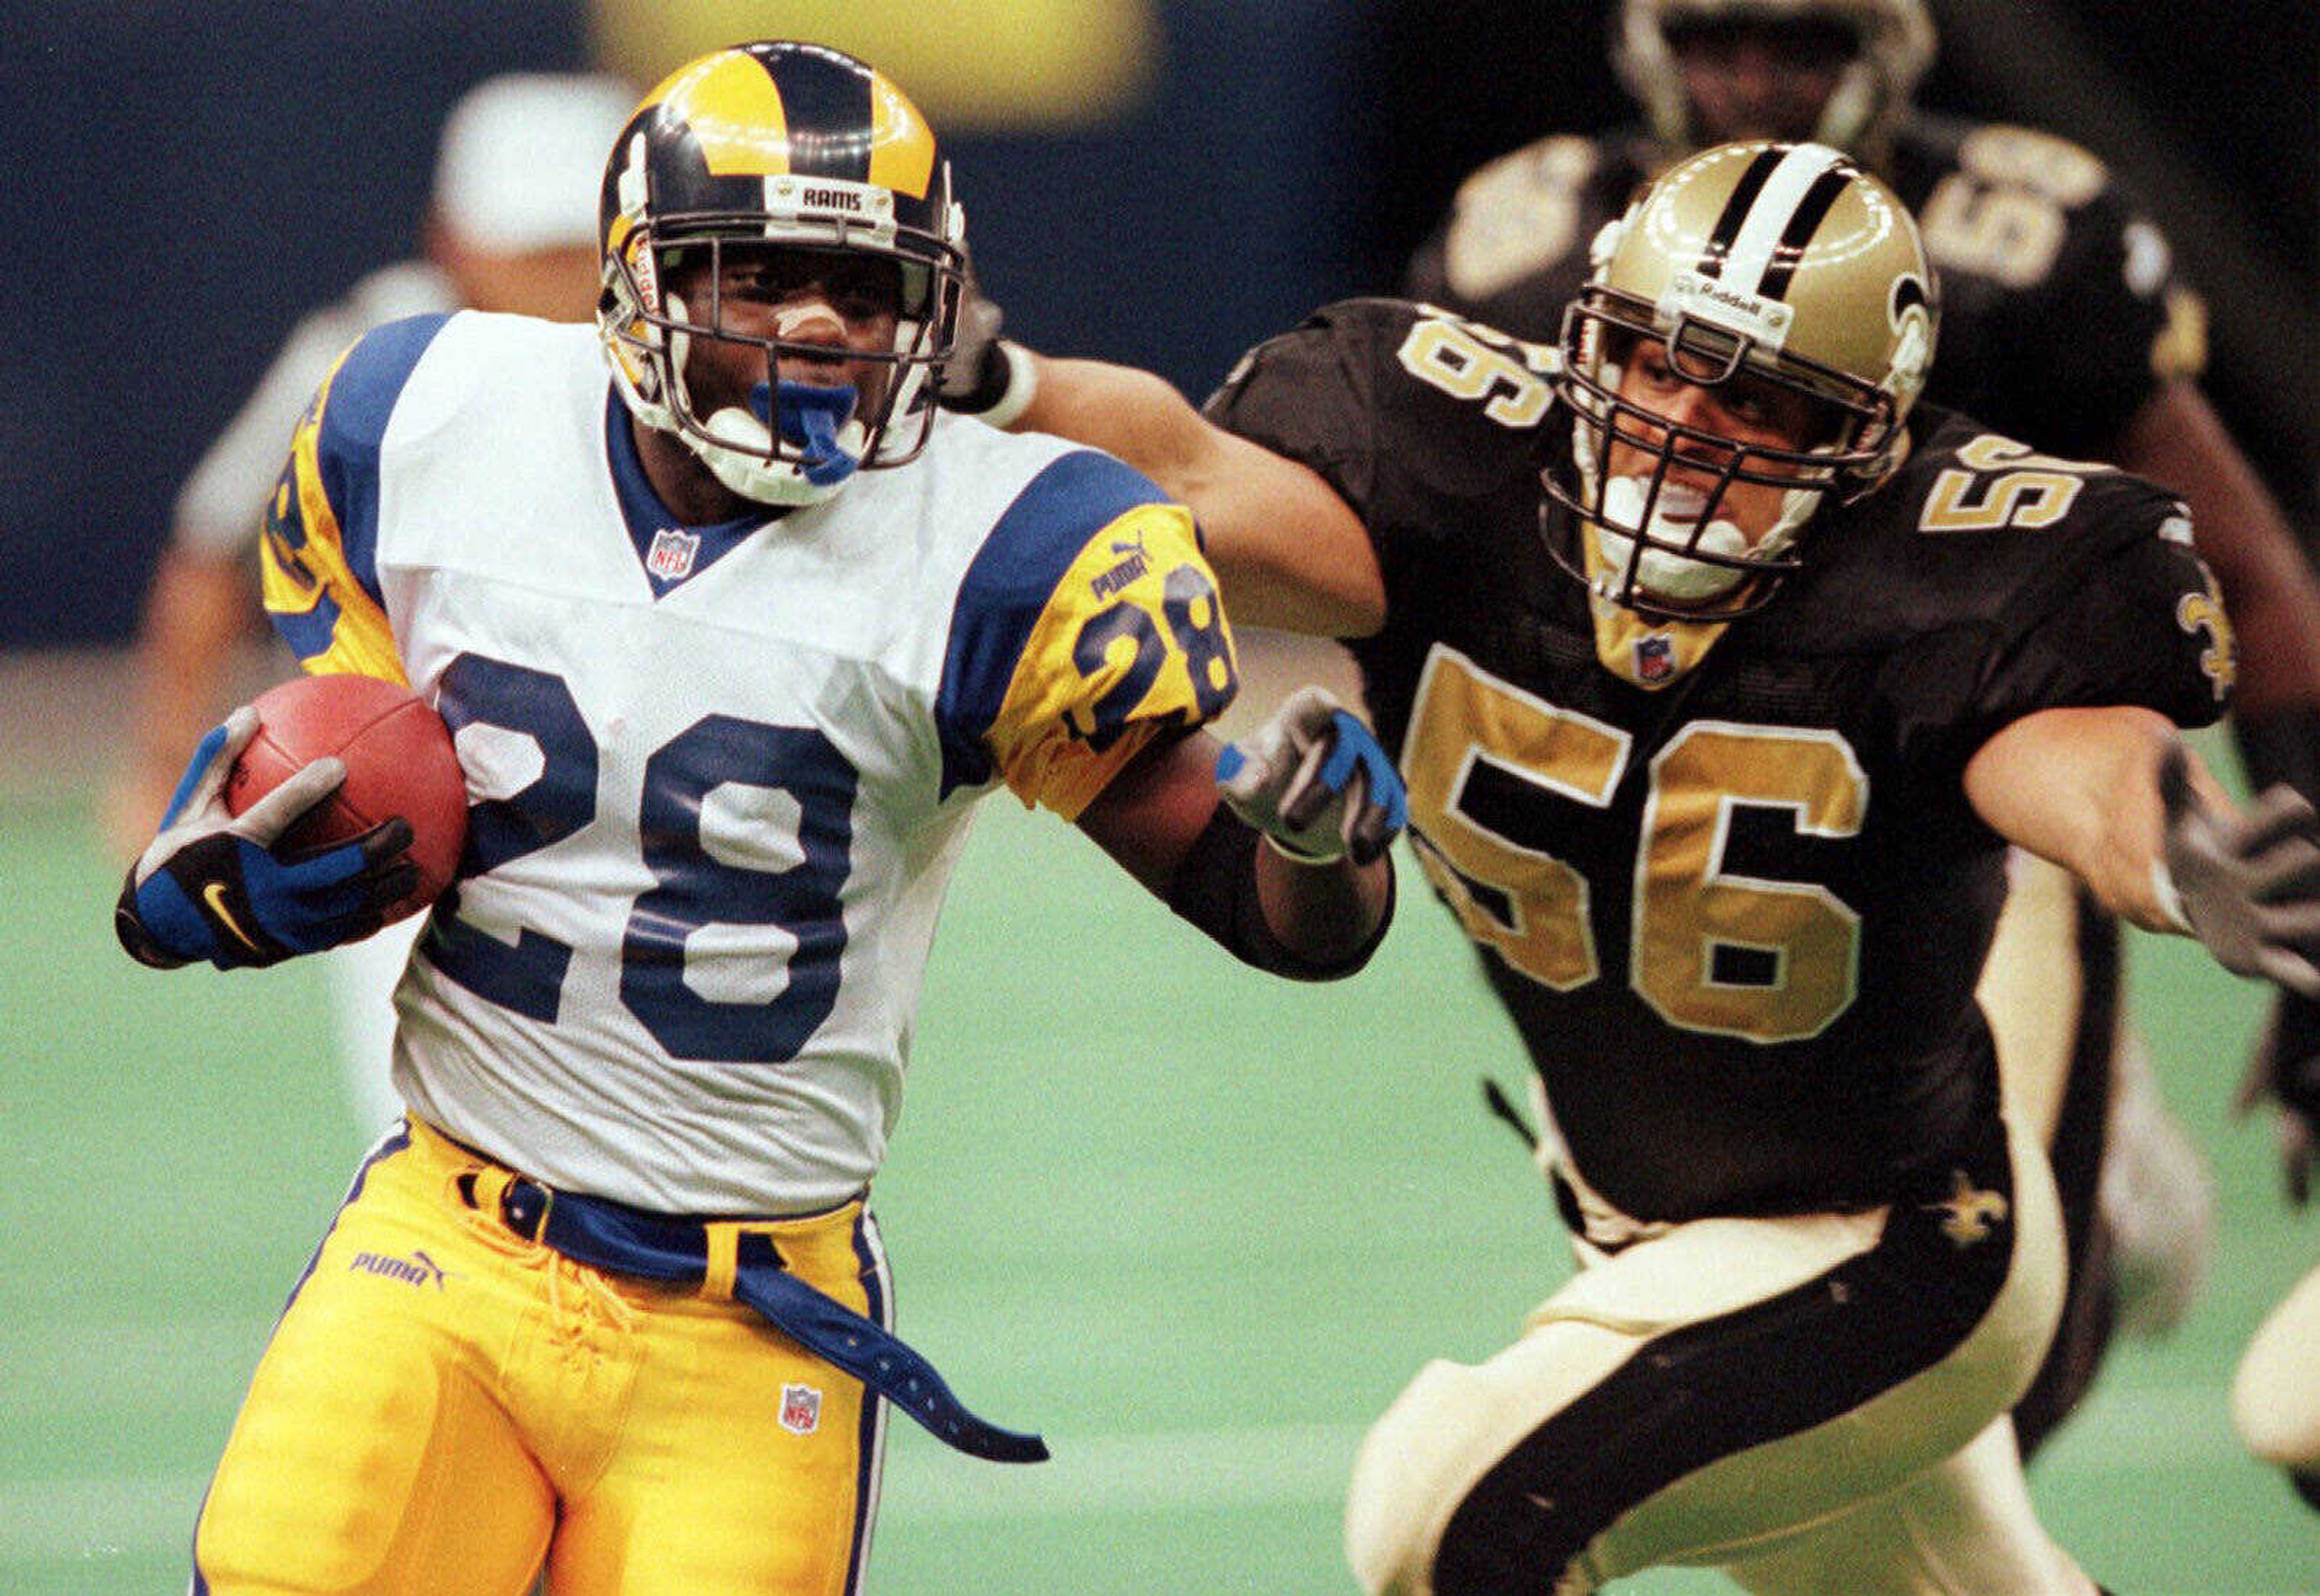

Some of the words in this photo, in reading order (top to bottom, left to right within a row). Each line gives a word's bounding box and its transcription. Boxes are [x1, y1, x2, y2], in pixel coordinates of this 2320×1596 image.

[801, 187, 861, 211] RAMS
[653, 548, 690, 572] NFL
[1091, 553, 1149, 603] PUMA
[1061, 563, 1240, 755] 28
[411, 651, 859, 1064] 28
[1399, 640, 1870, 1044] 56
[349, 1252, 428, 1288] PUMA
